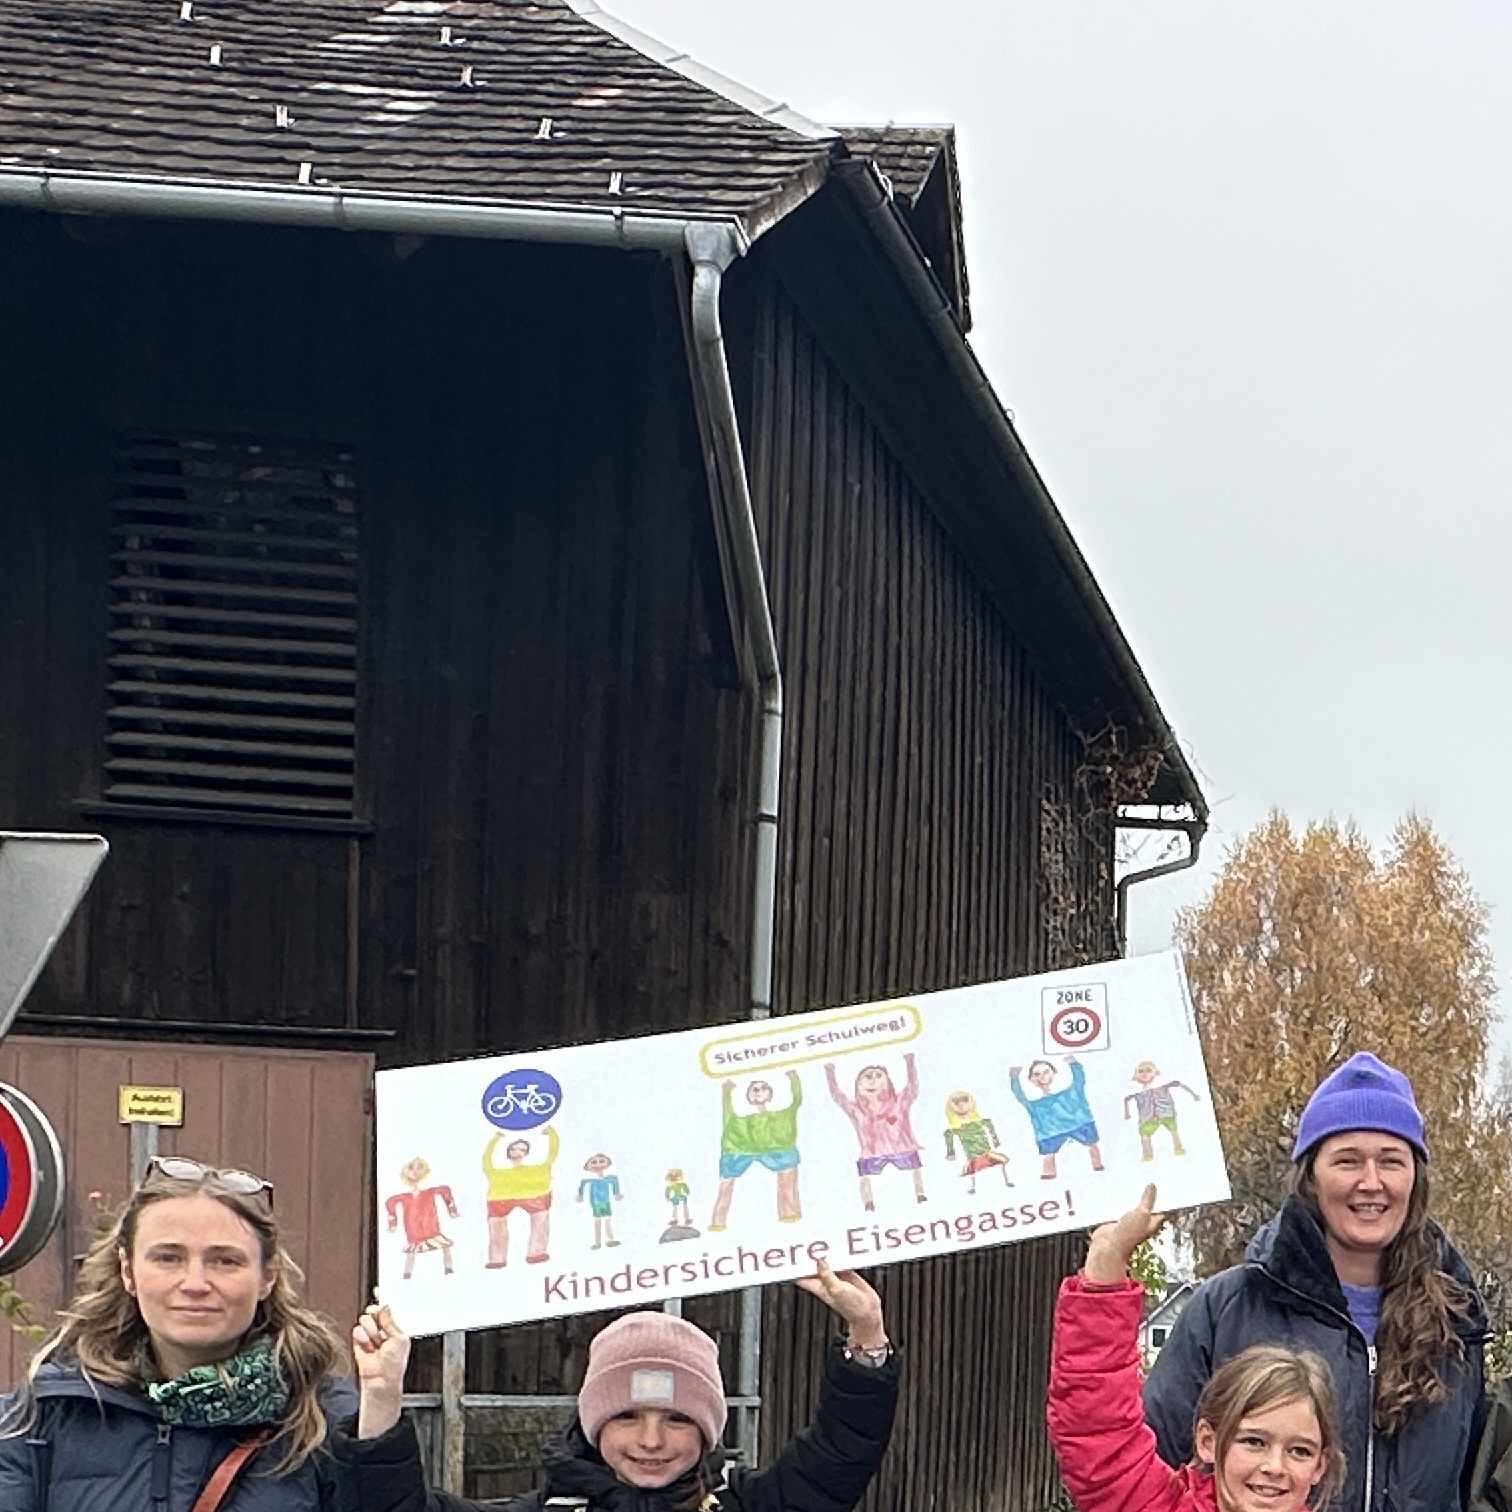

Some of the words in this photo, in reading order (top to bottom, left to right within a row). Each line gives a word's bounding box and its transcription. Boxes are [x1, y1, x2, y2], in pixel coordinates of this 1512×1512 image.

[1056, 988, 1093, 1005] ZONE
[714, 1040, 799, 1065] Sicherer
[804, 1015, 907, 1047] Schulweg!
[1062, 1018, 1090, 1036] 30
[543, 1240, 830, 1304] Kindersichere
[846, 1190, 1077, 1256] Eisengasse!
